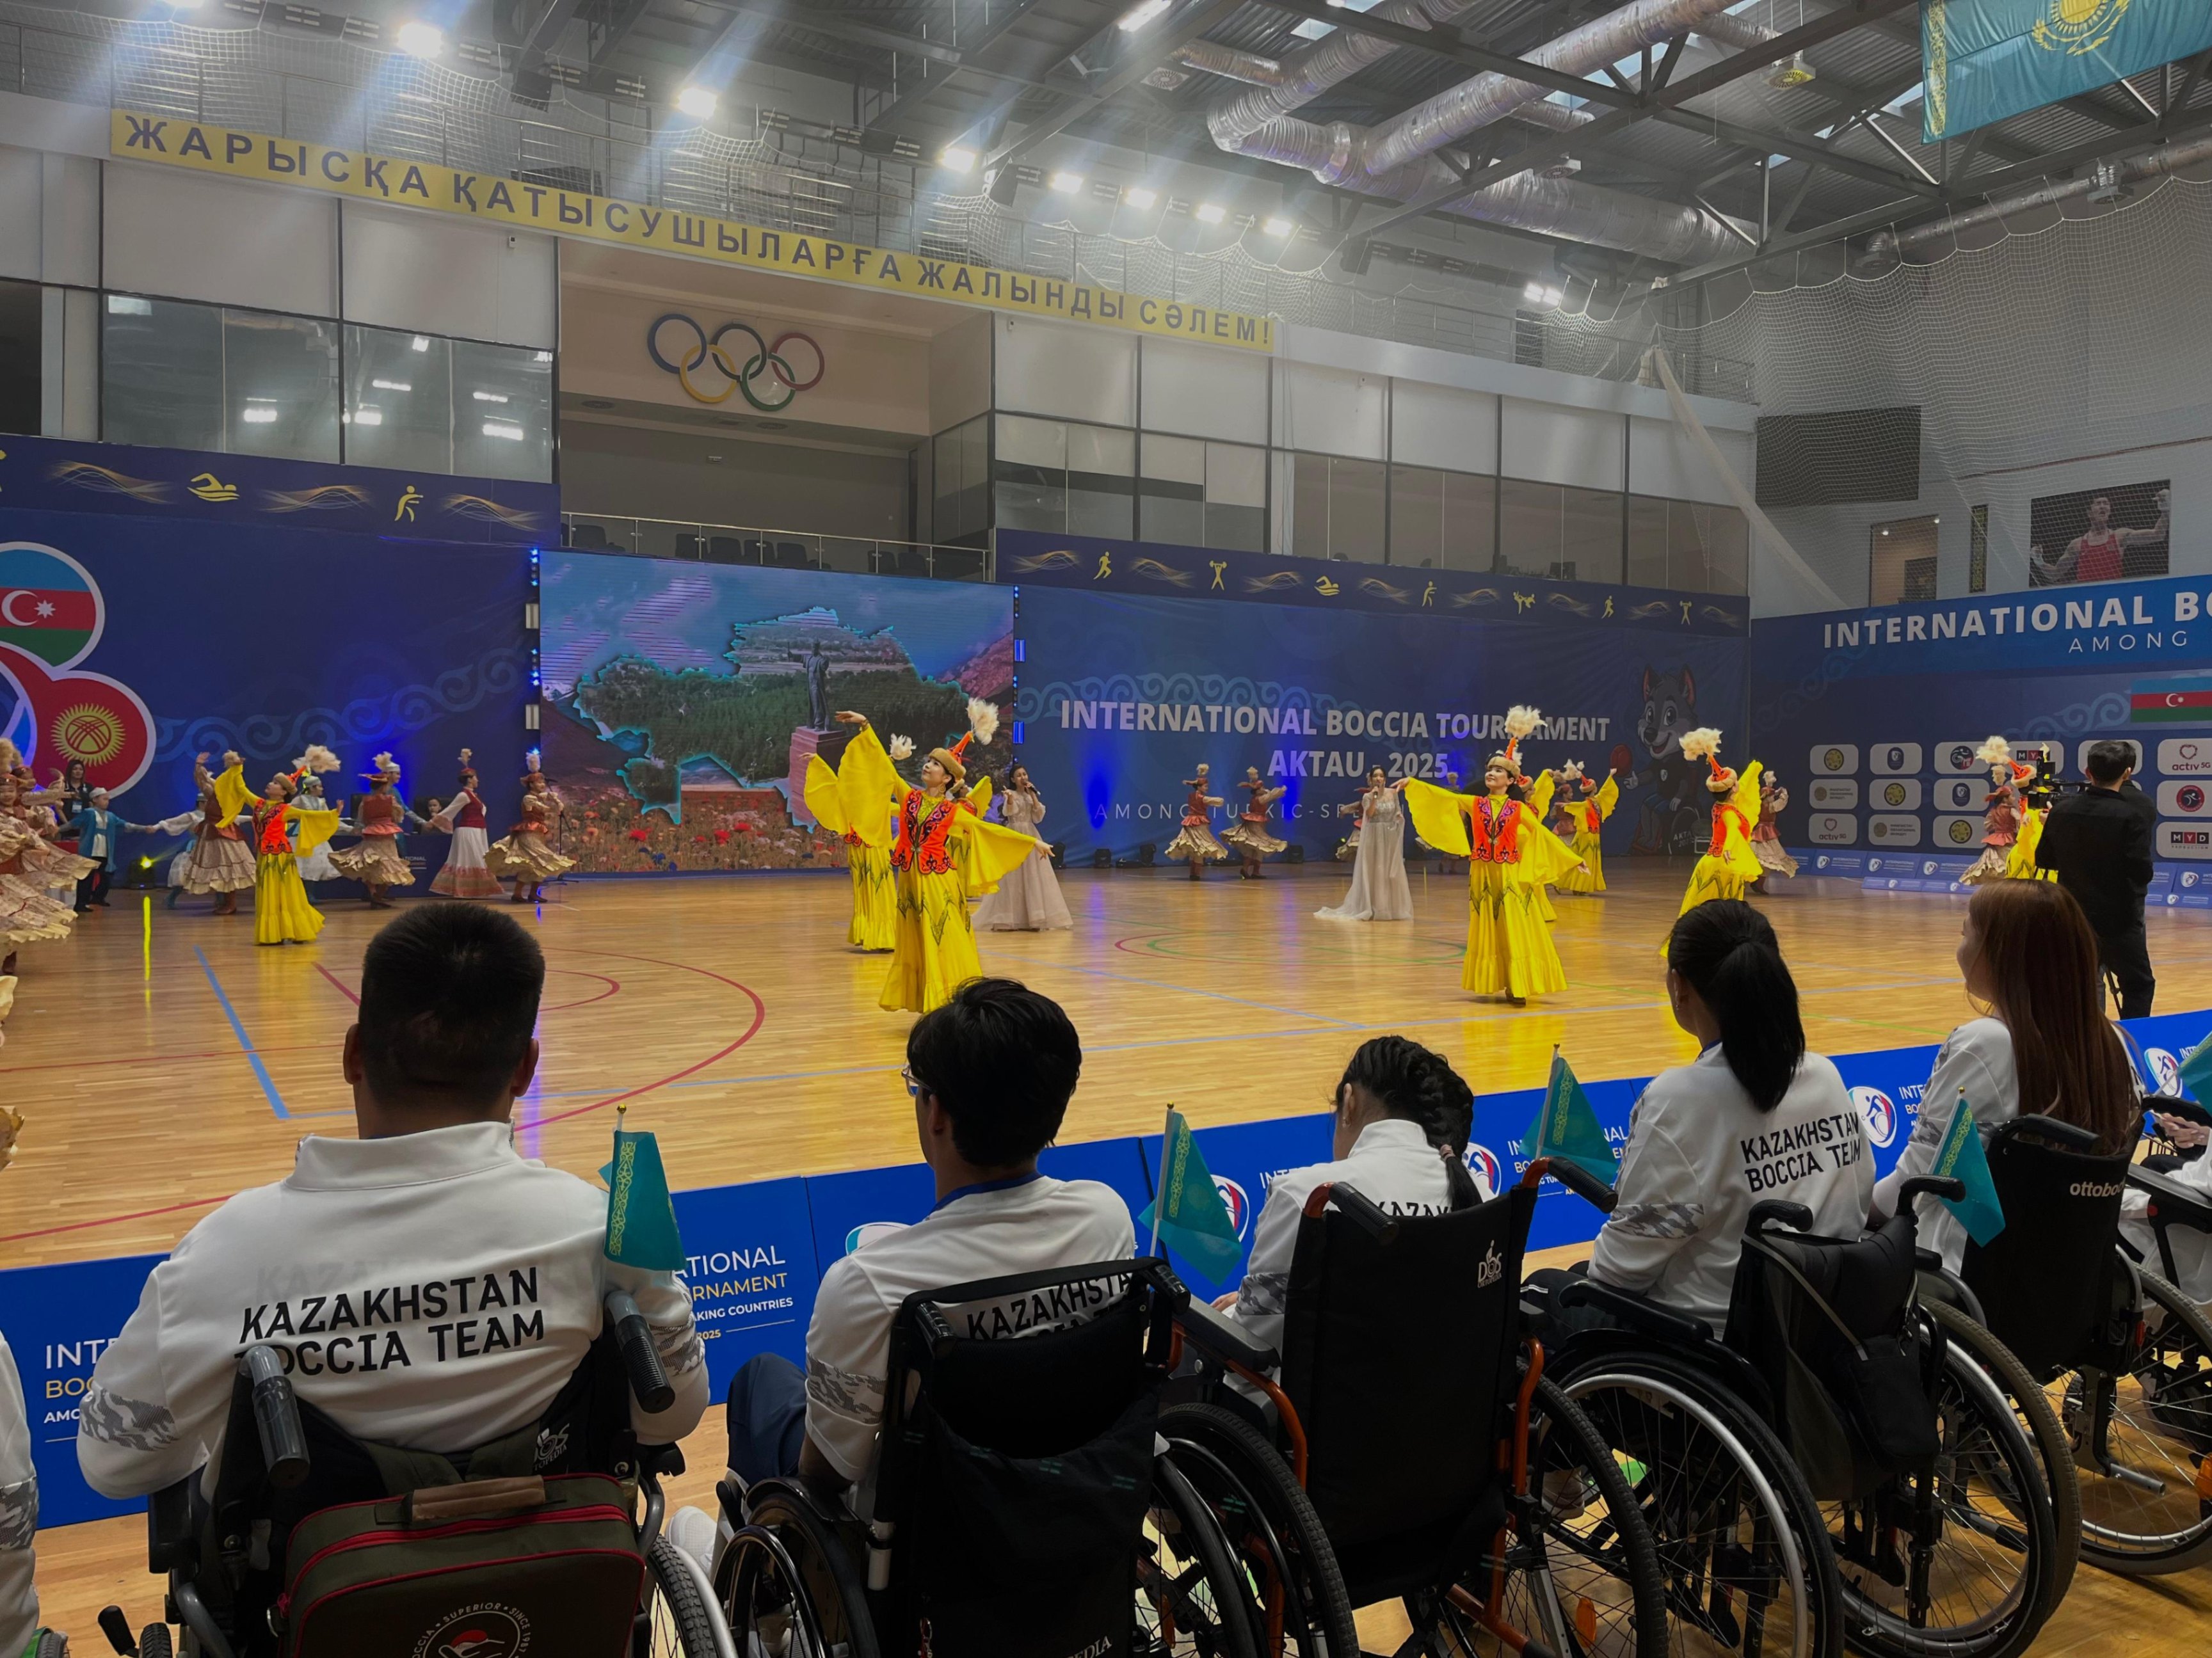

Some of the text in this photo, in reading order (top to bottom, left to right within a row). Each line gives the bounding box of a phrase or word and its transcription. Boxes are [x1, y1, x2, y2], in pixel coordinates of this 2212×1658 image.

[125, 115, 1269, 345] ЖАРЫСҚА ҚАТЫСУШЫЛАРҒА ЖАЛЫНДЫ СӘЛЕМ!
[1823, 591, 2212, 649] INTERNATIONAL B
[2068, 630, 2187, 654] AMONG
[1061, 699, 1610, 742] INTERNATIONAL BOCCIA TOURAMENT
[1267, 749, 1365, 777] AKTAU
[1388, 752, 1448, 779] 2025
[2173, 834, 2206, 842] MYD
[1740, 1112, 1859, 1164] KAZAKHSTAN
[1744, 1151, 1824, 1193] BOCCIA
[239, 1266, 538, 1344] KAZAKHSTAN
[728, 1296, 794, 1316] COUNTRIES
[234, 1309, 545, 1376] OCCIA TEAM
[442, 1602, 502, 1623] SUPERIOR
[508, 1607, 531, 1630] SINCE
[518, 1631, 532, 1653] 1987
